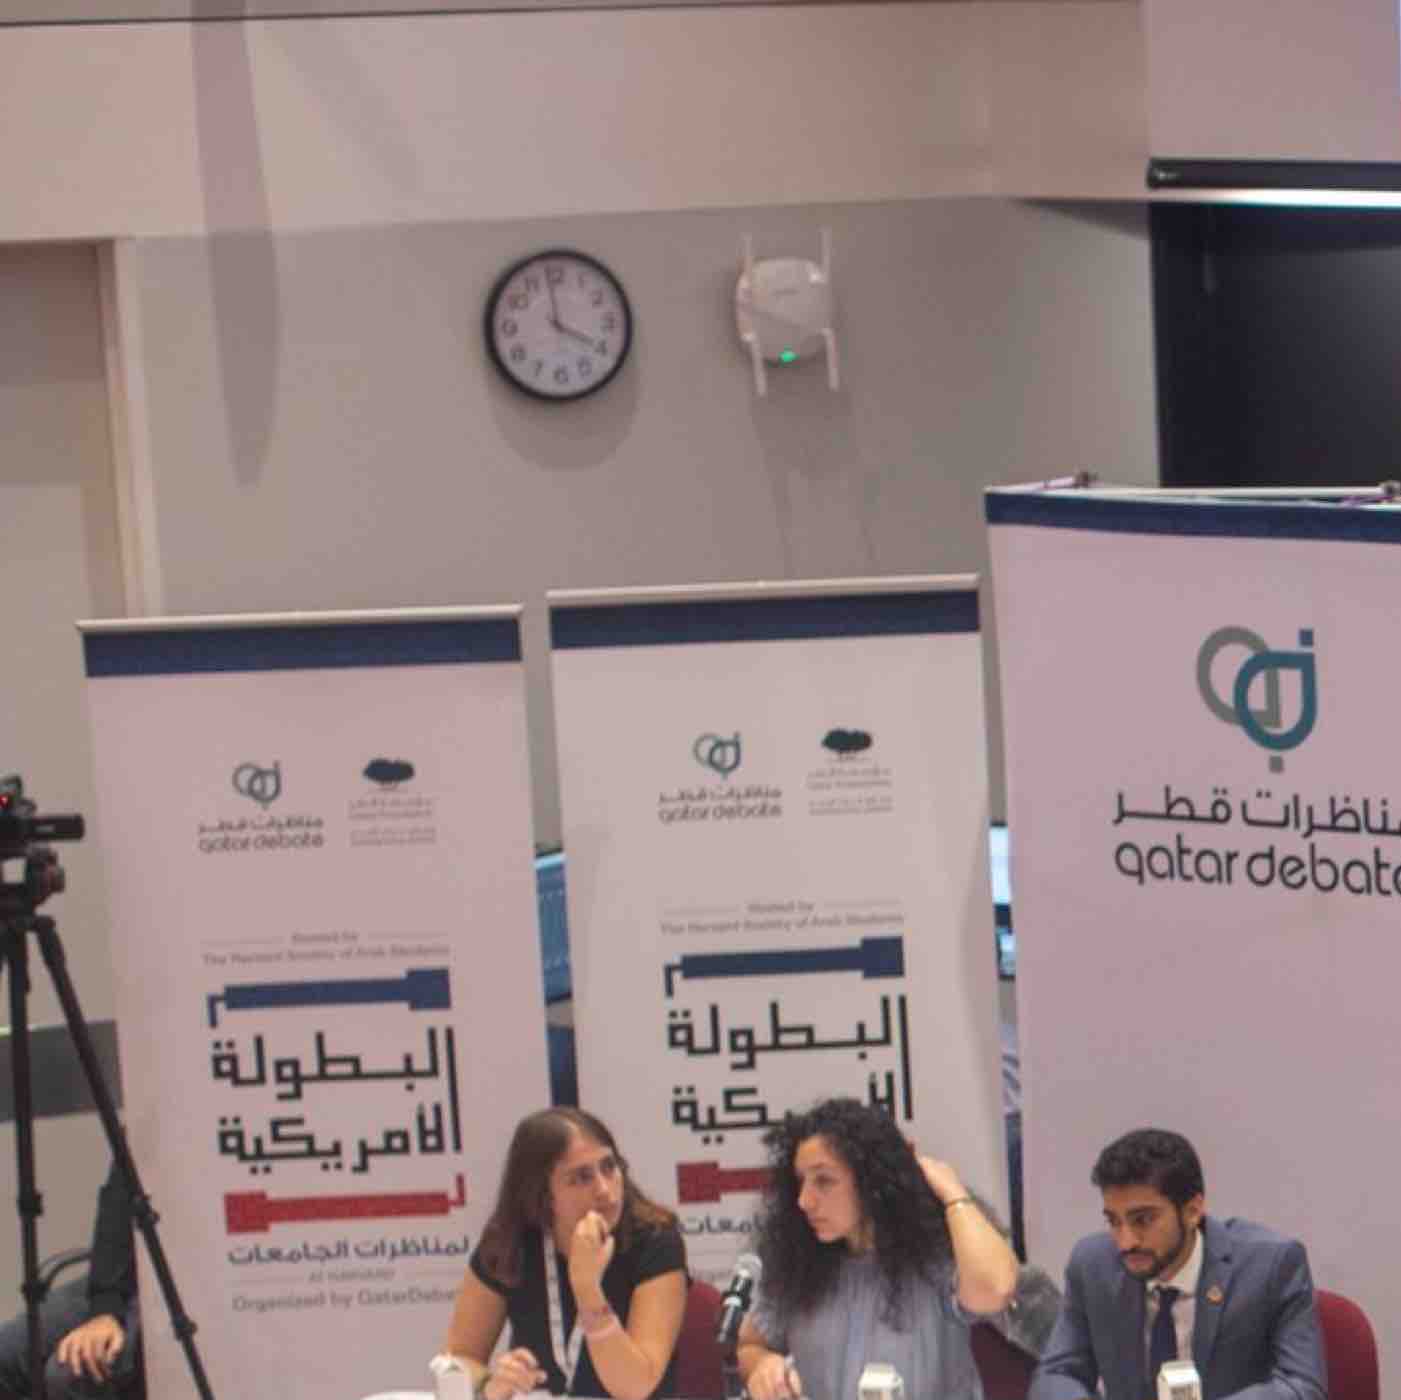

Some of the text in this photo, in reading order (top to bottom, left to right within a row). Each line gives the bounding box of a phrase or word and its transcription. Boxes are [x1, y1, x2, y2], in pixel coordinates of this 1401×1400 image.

[1113, 785, 1232, 826] قطر
[668, 993, 912, 1071] البطولة
[210, 1025, 461, 1100] البطولة
[329, 1290, 354, 1308] by
